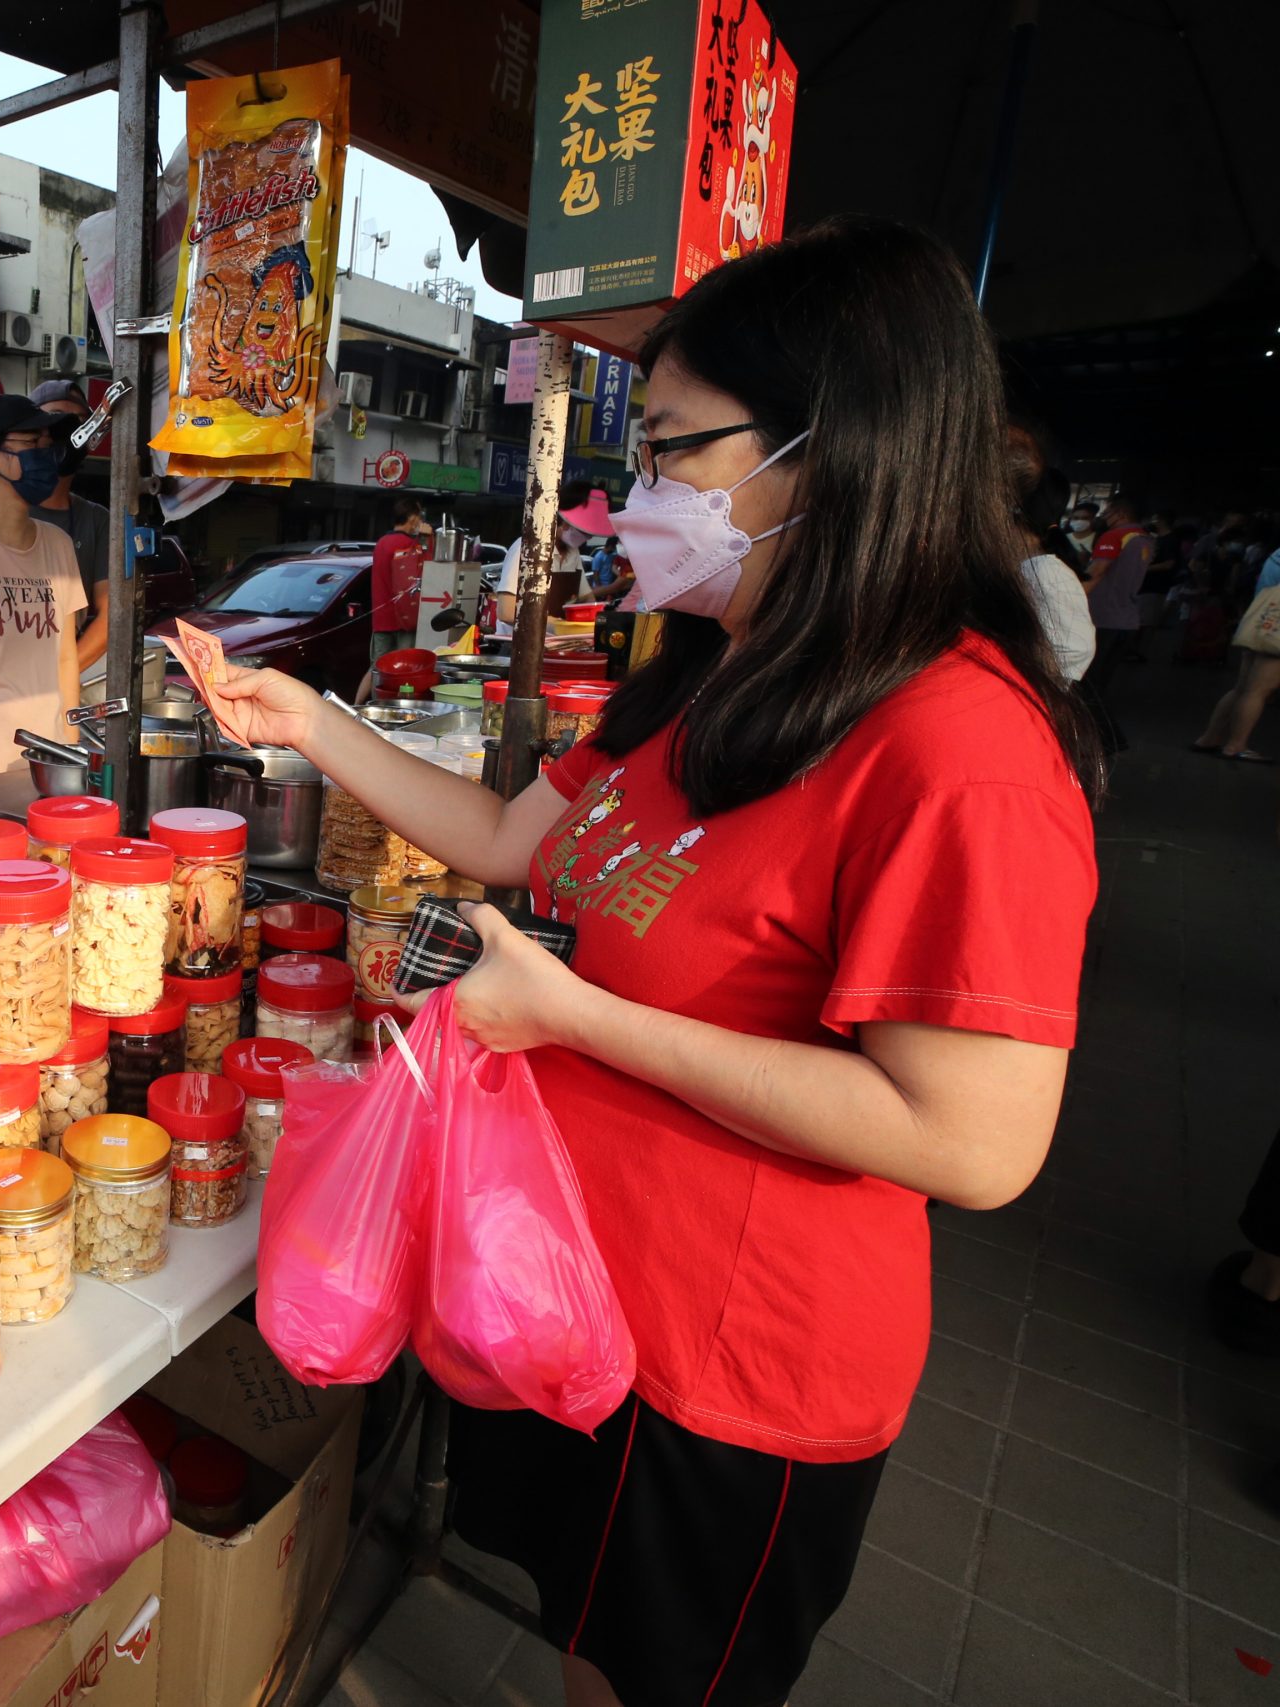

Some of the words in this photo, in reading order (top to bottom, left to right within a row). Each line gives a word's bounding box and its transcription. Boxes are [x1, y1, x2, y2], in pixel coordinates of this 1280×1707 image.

[559, 72, 609, 217] 大礼包
[609, 55, 662, 162] 坚果
[188, 164, 322, 244] Cuttlefish
[3, 586, 55, 606] WEAR
